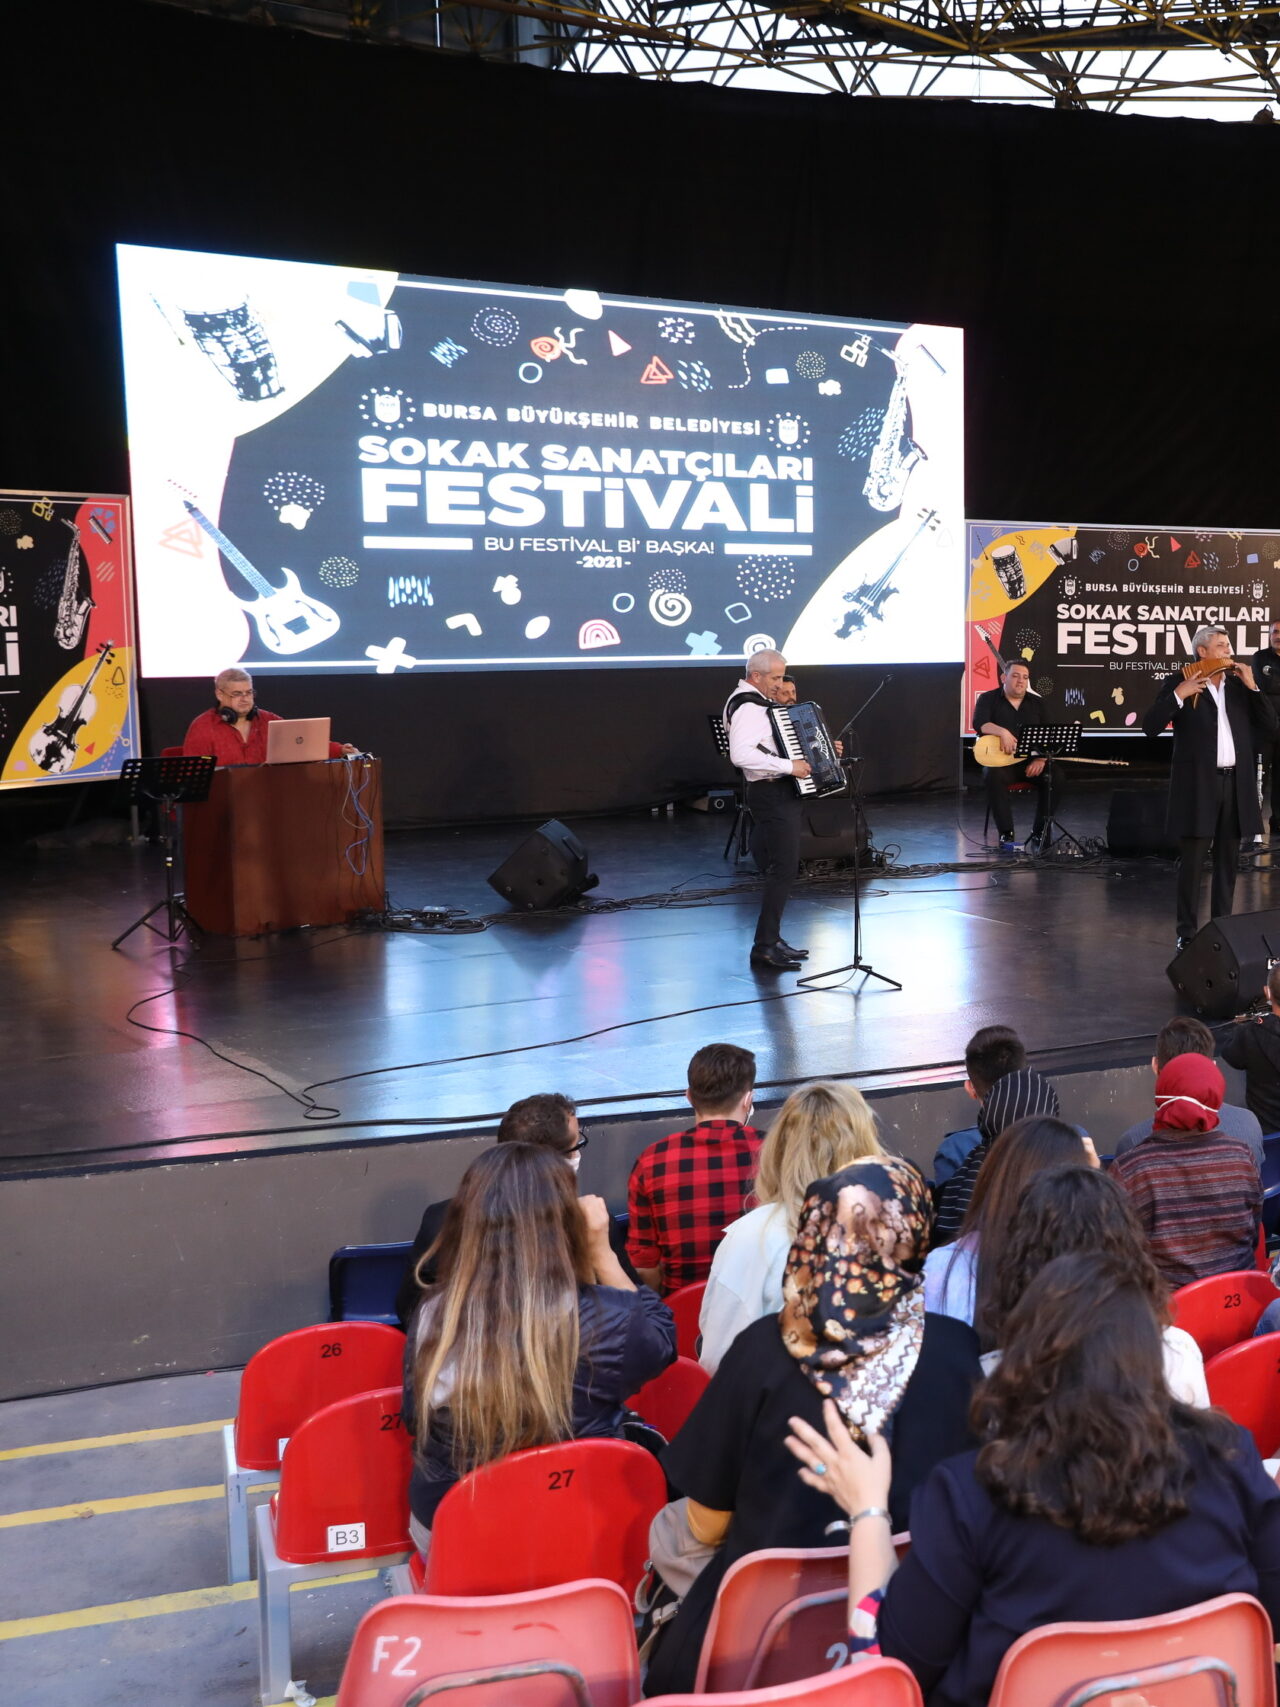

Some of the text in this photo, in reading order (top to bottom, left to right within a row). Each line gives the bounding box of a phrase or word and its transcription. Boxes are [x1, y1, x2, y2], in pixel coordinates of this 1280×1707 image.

[423, 402, 760, 436] BURSA BÜYÜKŞEHİR BELEDİYESİ
[358, 436, 813, 481] SOKAK SANATÇILARI
[484, 537, 516, 551] BU
[520, 535, 613, 553] FESTİVAL
[646, 540, 714, 556] BAŞKA!
[1085, 582, 1244, 595] BURSA BÜYÜKŞEHİR BELEDİYESİ
[1056, 603, 1270, 625] SOKAK SANATÇILARI
[1109, 662, 1123, 670] BU
[1224, 1293, 1241, 1308] 23
[320, 1342, 342, 1358] 26
[548, 1469, 575, 1490] 27
[335, 1529, 359, 1545] B3
[371, 1635, 422, 1677] F2
